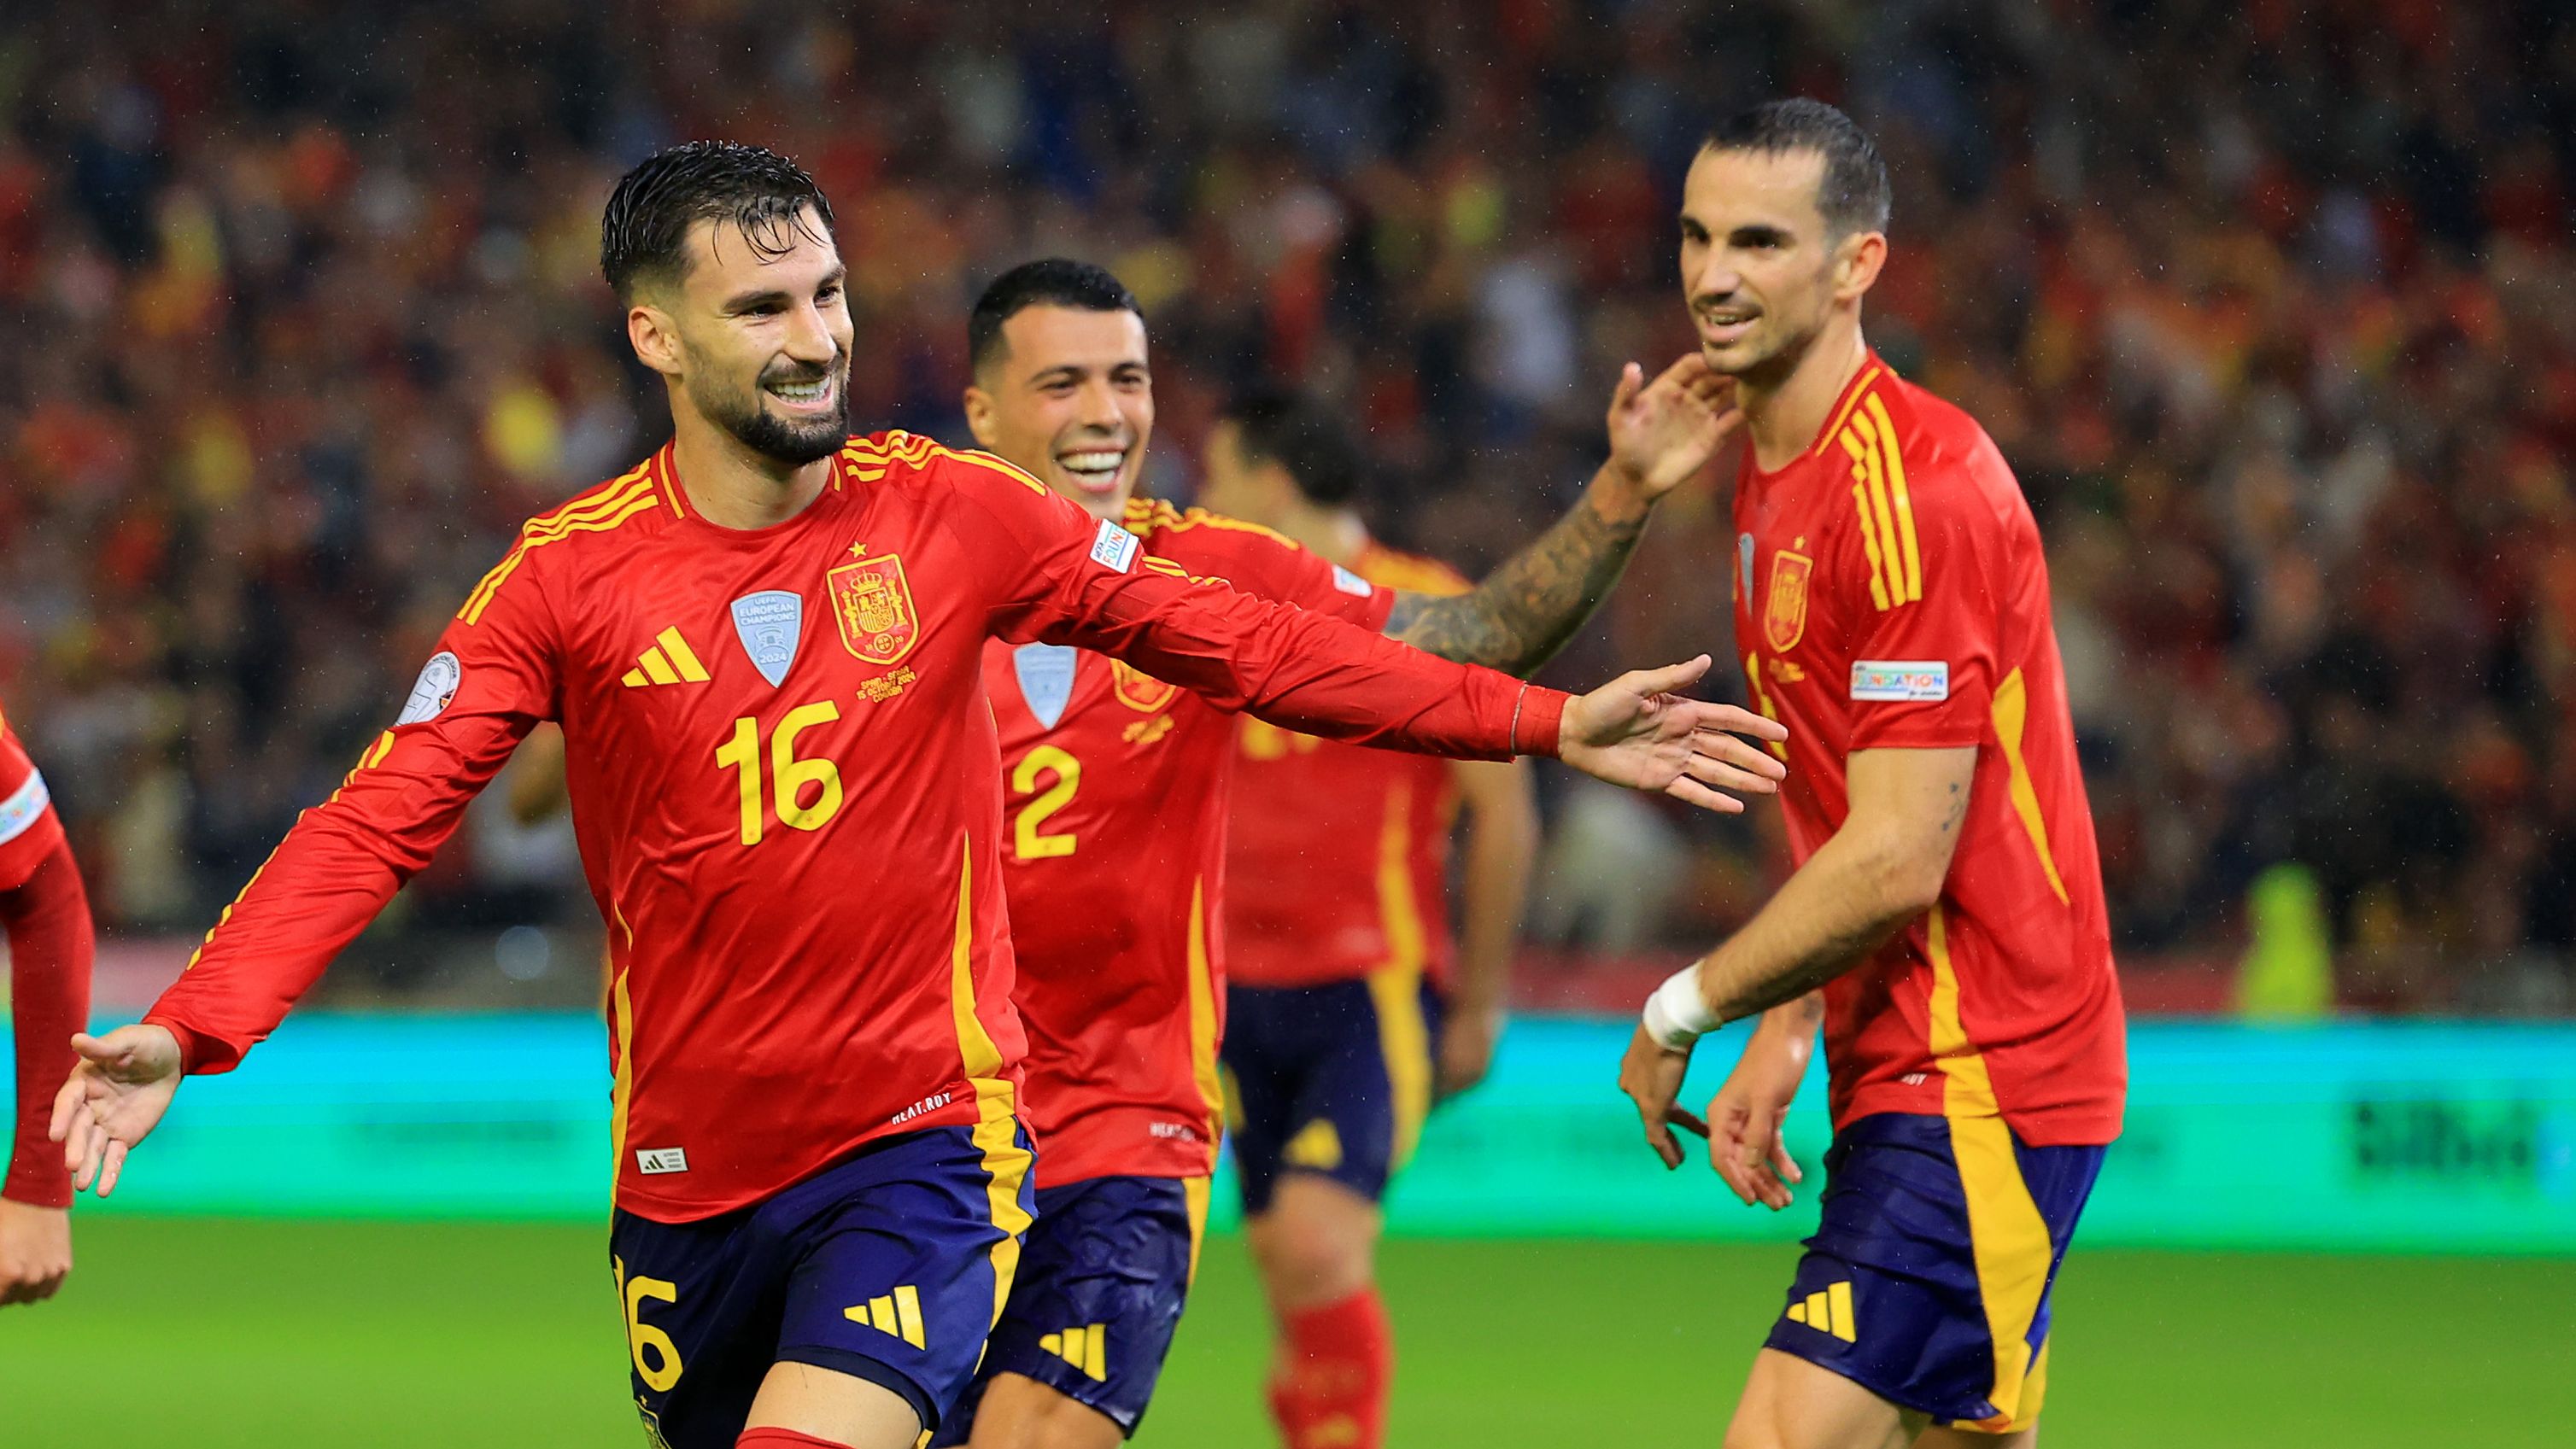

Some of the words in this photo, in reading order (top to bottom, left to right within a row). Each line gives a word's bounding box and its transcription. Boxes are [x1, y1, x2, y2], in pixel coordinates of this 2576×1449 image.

[739, 604, 794, 616] EUROPEAN
[741, 612, 796, 625] CHAMPIONS
[759, 653, 787, 663] 2024
[857, 690, 867, 700] 15
[898, 671, 916, 685] 2024
[716, 700, 844, 845] 16
[1013, 745, 1081, 859] 2
